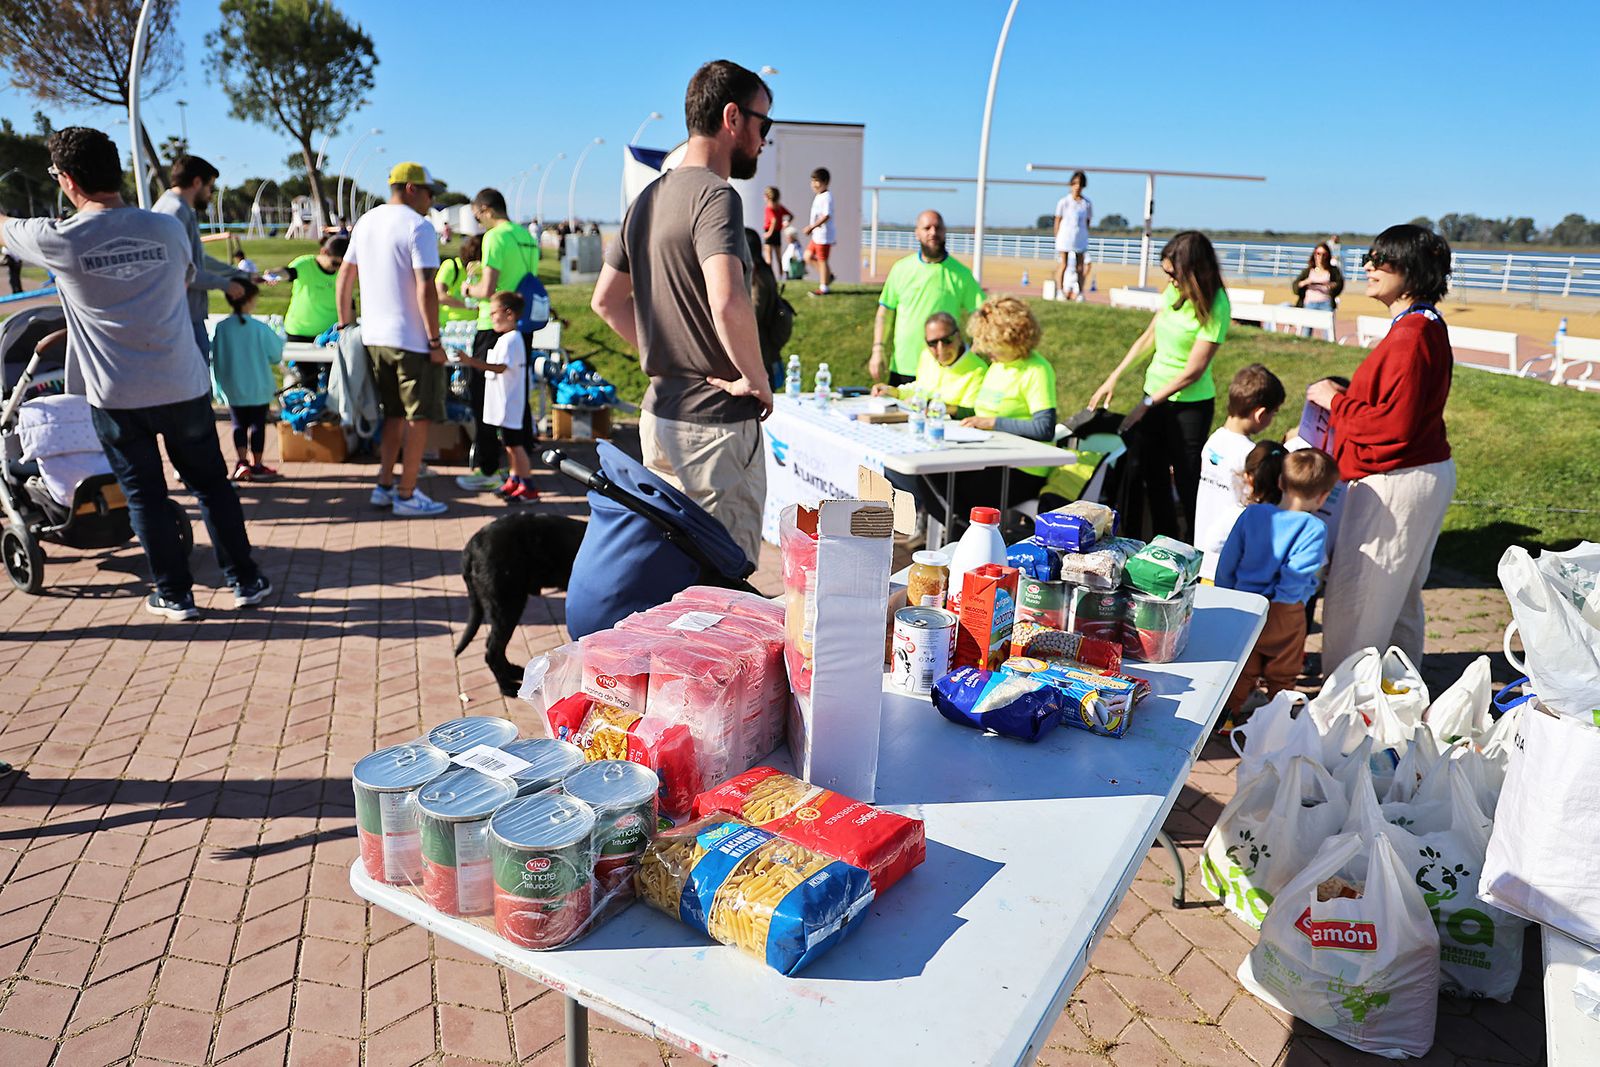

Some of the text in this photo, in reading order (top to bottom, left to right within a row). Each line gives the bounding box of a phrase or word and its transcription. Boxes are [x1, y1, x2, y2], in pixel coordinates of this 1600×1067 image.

[83, 247, 163, 271] MOTORCYCLE
[604, 693, 614, 702] de
[614, 697, 630, 708] Trigo
[521, 871, 556, 880] Tomate
[524, 881, 554, 889] Triturado
